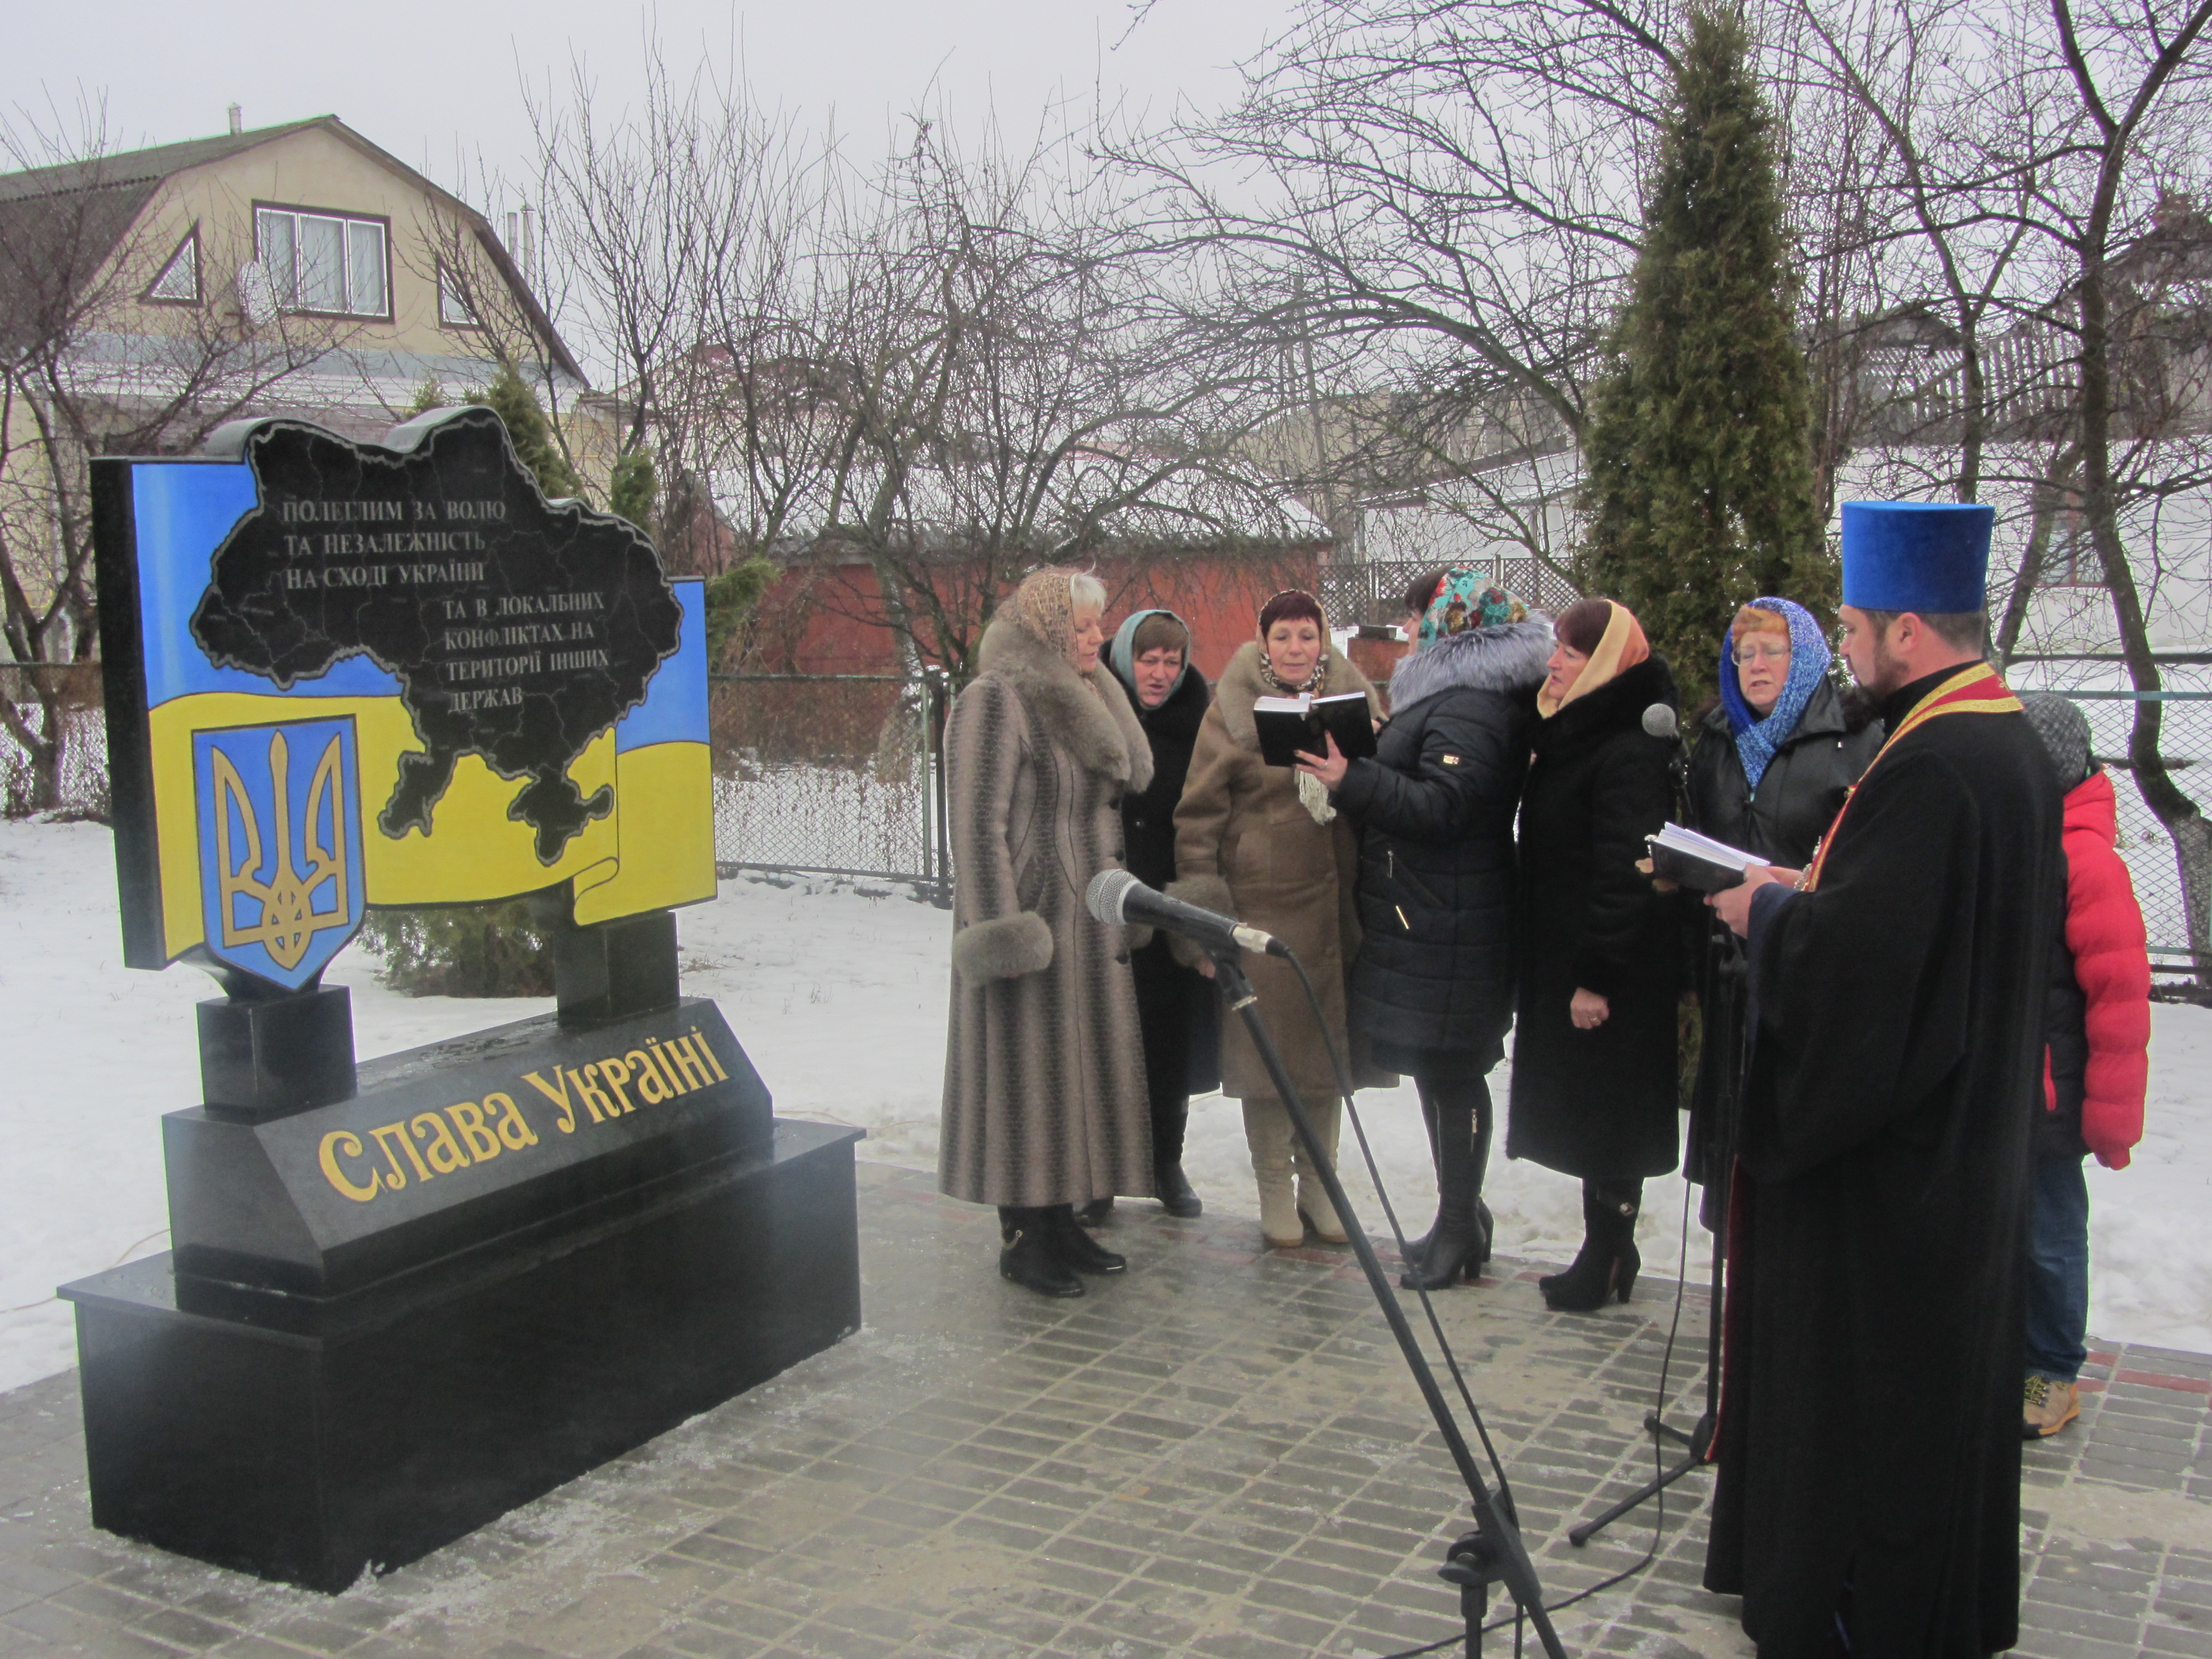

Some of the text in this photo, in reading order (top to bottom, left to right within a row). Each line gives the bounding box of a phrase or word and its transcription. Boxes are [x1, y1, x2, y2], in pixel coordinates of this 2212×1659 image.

[283, 500, 506, 521] ПОЛЕГЛИМ ЗА ВОЛЮ
[284, 532, 485, 556] ТА НЕЗАЛЕЖНІСТЬ
[285, 559, 484, 589] НА СХОДІ УКРАЇНИ
[443, 601, 466, 619] ТА
[476, 599, 487, 617] В
[445, 622, 594, 650] КОНФЛІКТАХ НА
[446, 649, 609, 681] ТЕРИТОРІЇ ІНШИХ
[448, 687, 523, 713] ДЕРЖАВ
[319, 1091, 539, 1204] Слава
